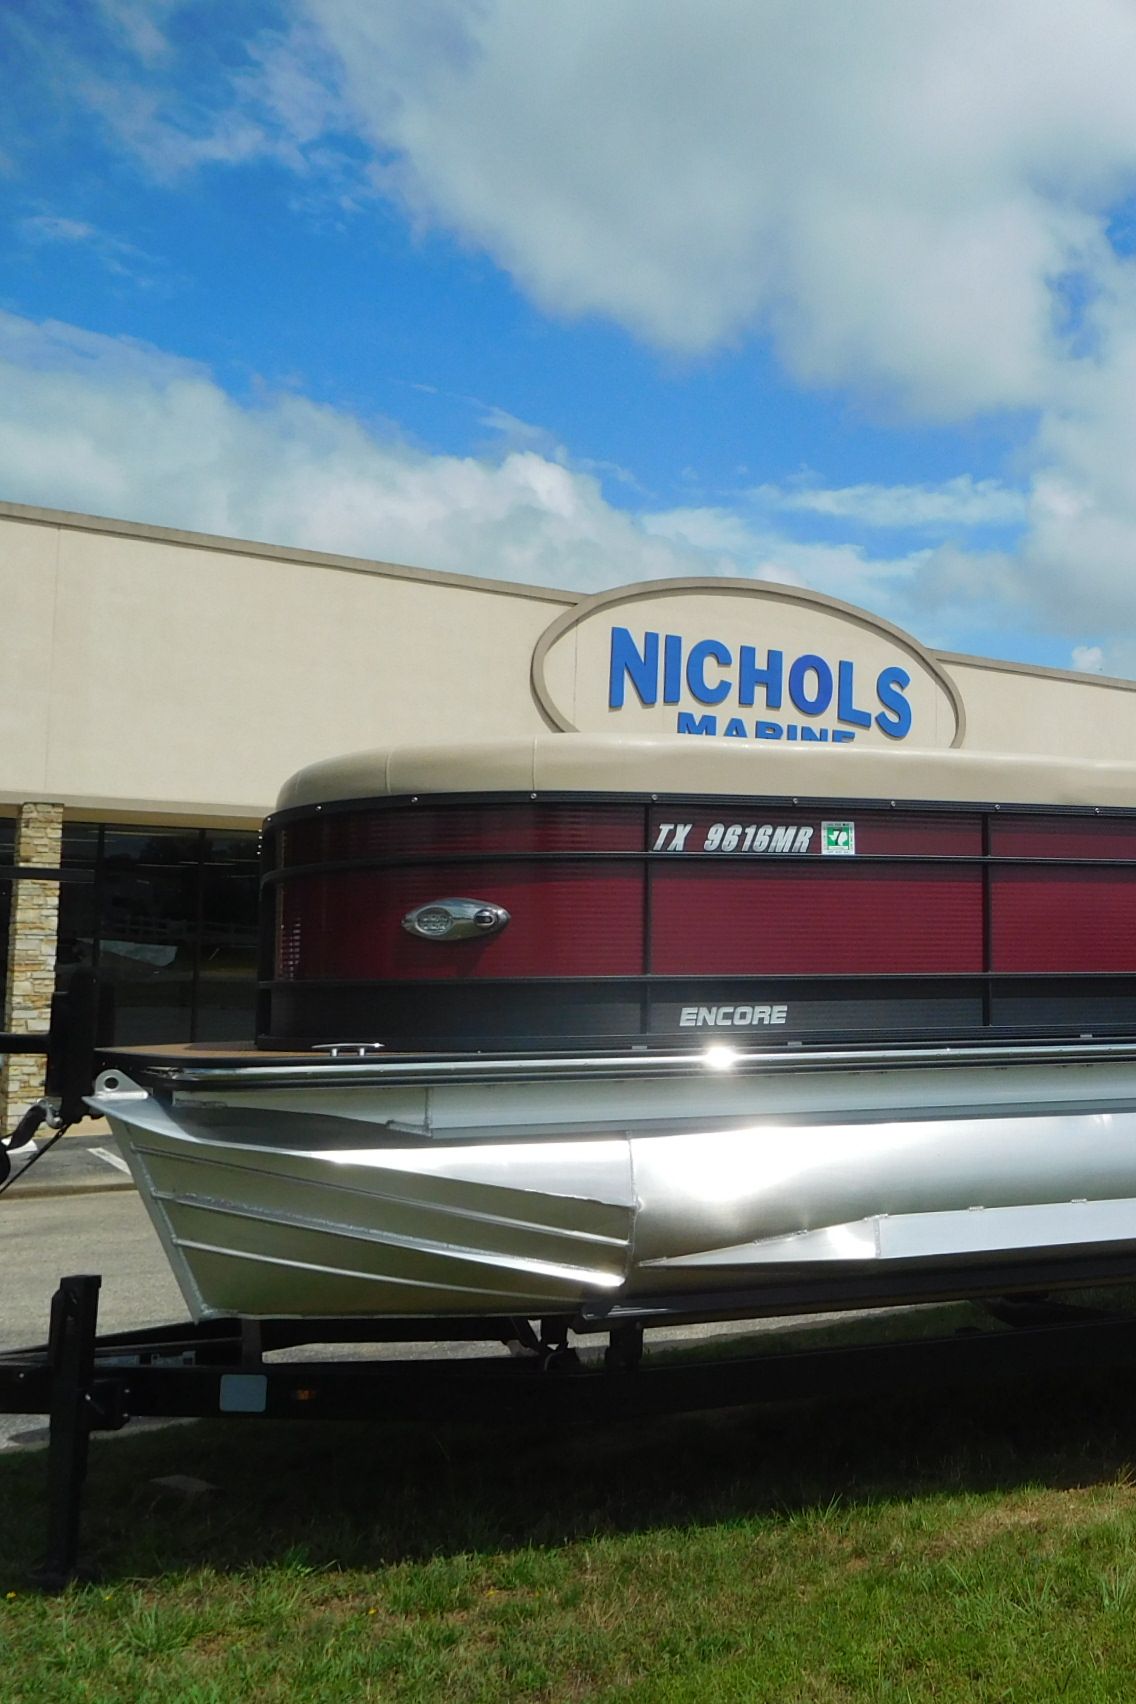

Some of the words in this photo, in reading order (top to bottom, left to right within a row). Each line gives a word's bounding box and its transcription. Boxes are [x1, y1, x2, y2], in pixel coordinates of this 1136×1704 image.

[608, 626, 912, 739] NICHOLS
[652, 823, 693, 851] TX
[703, 823, 814, 853] 9616MR
[679, 1004, 788, 1026] ENCORE
